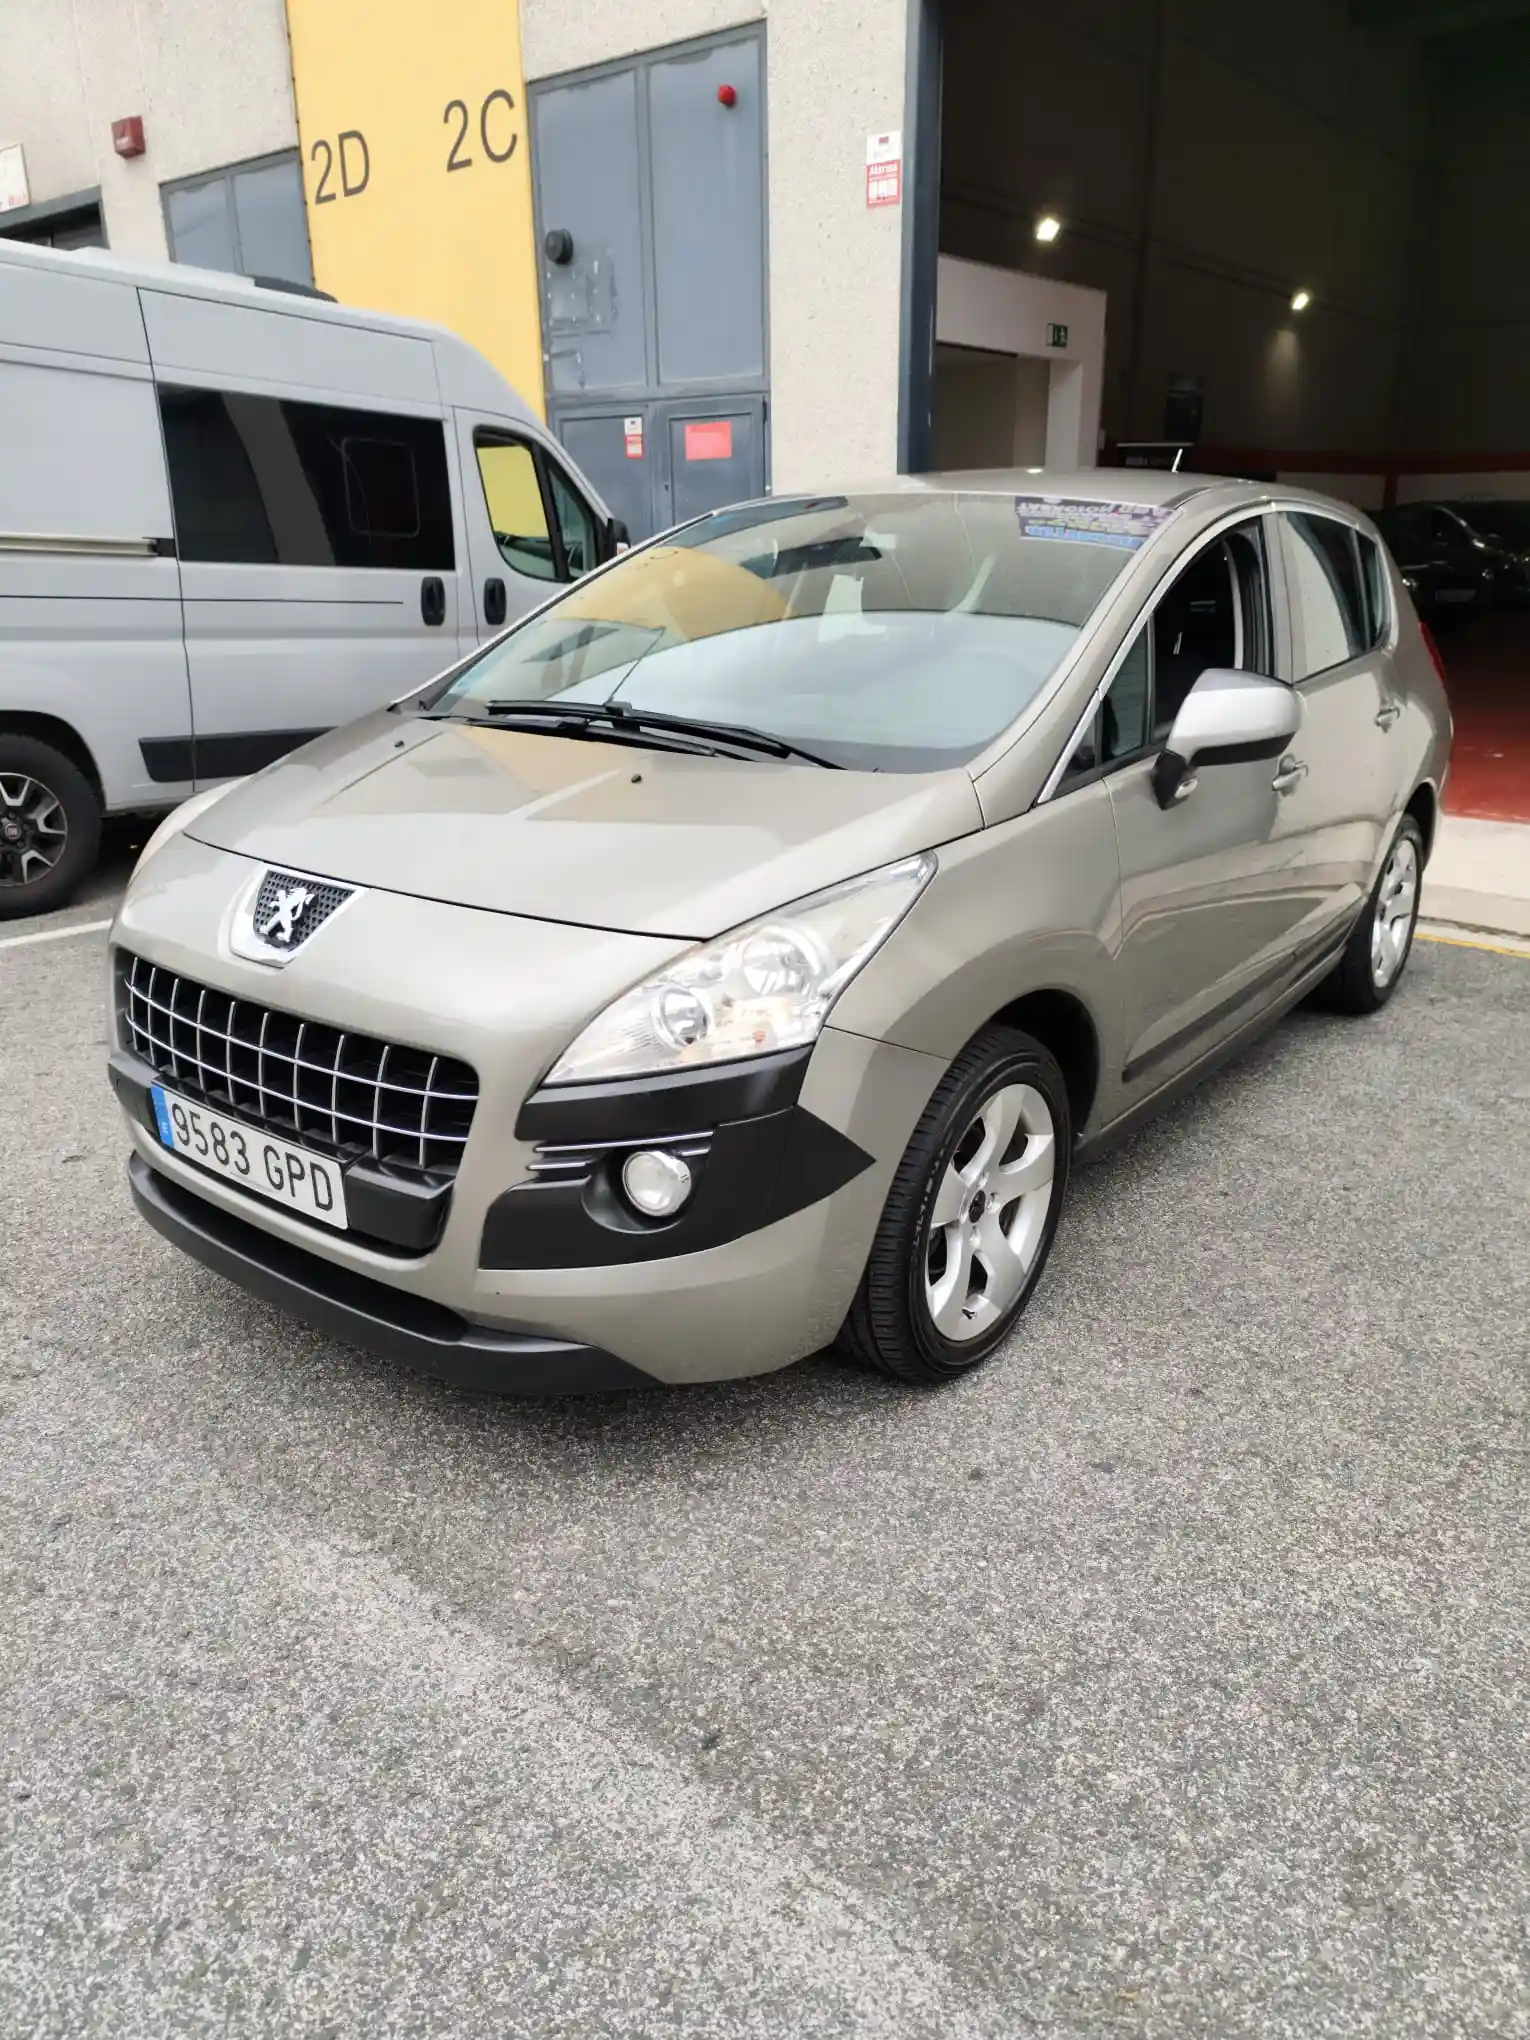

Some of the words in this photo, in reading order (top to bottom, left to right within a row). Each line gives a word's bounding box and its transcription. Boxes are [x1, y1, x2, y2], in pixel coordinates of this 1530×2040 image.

[310, 130, 370, 205] 2D
[443, 88, 518, 172] 2C
[171, 1102, 250, 1176] 9583
[263, 1144, 334, 1212] GPD
